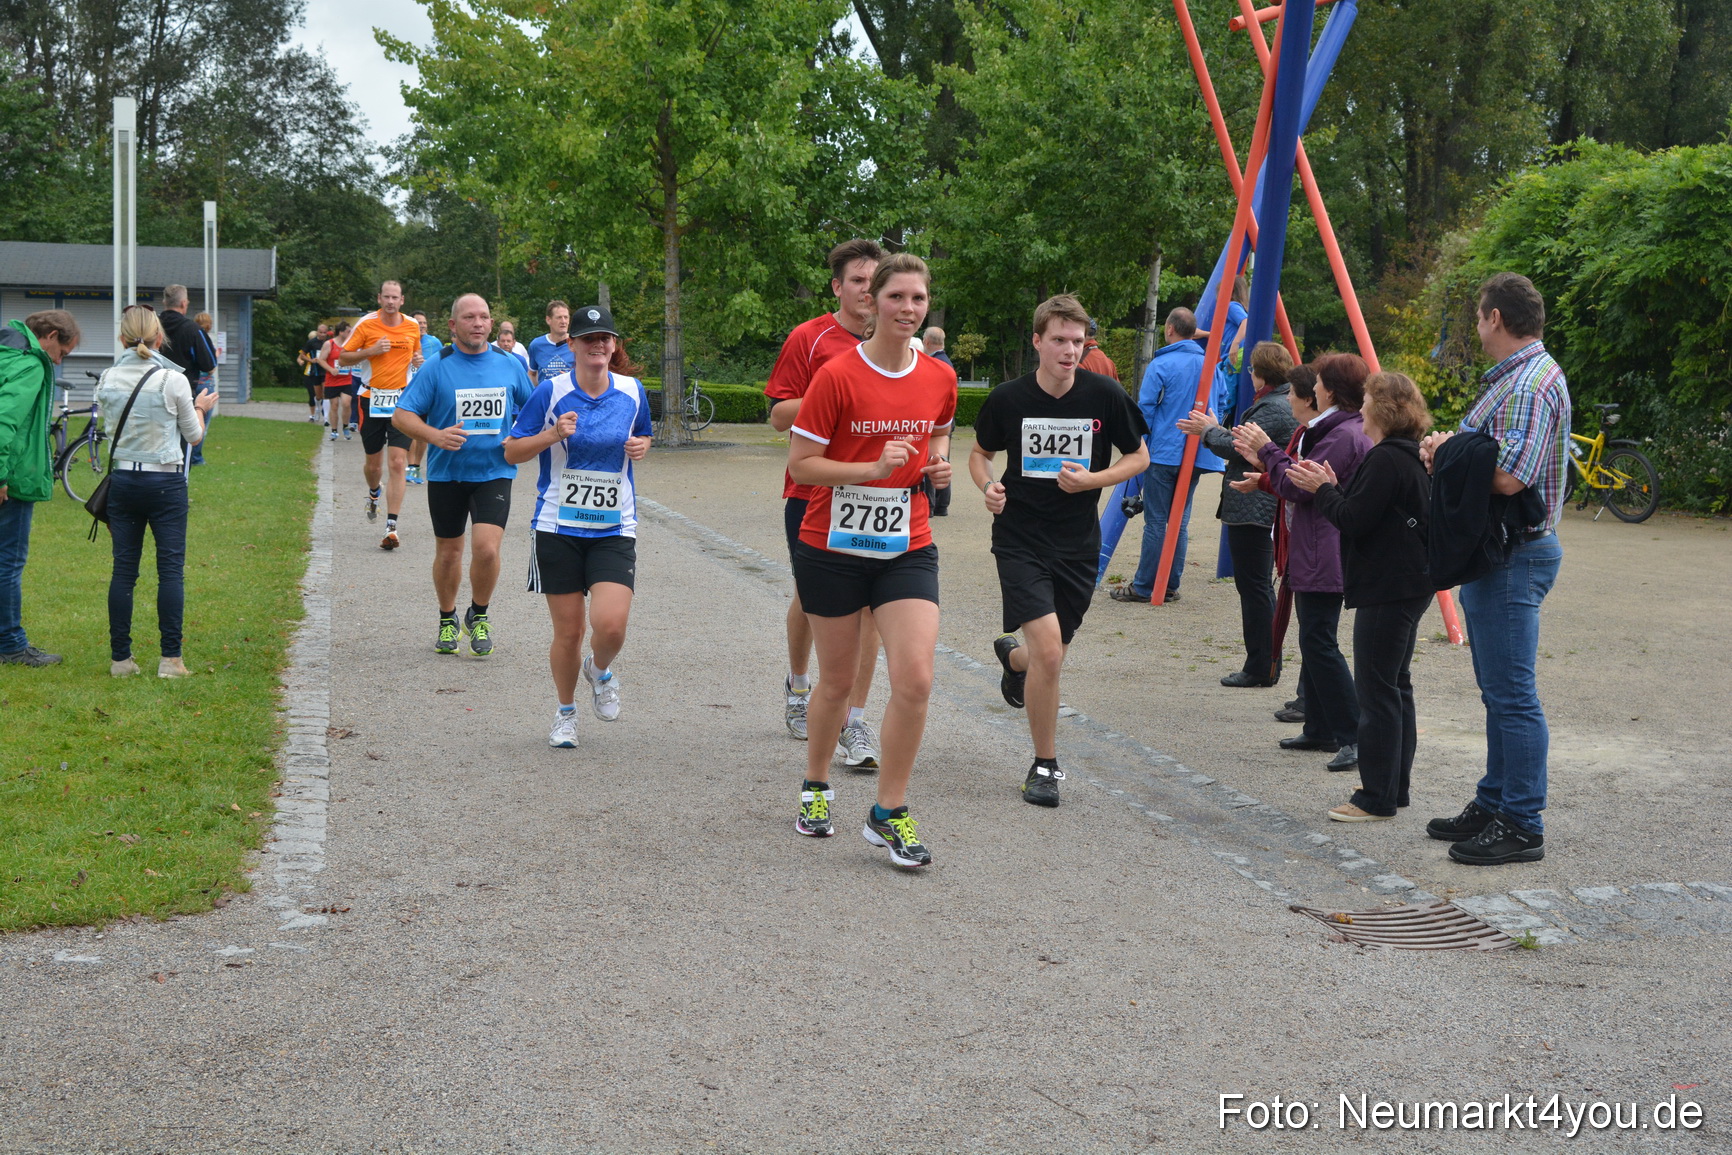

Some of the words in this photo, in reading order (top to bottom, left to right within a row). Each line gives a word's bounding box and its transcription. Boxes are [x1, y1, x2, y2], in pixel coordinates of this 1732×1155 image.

[374, 394, 398, 406] 2770
[462, 399, 502, 417] 2290
[851, 420, 927, 433] NEUMARKT
[1029, 433, 1083, 456] 3421
[562, 474, 583, 482] PARTL
[565, 483, 618, 508] 2753
[834, 491, 860, 500] PARTL
[575, 511, 604, 521] Jasmin
[839, 503, 903, 532] 2782
[851, 537, 887, 550] Sabine
